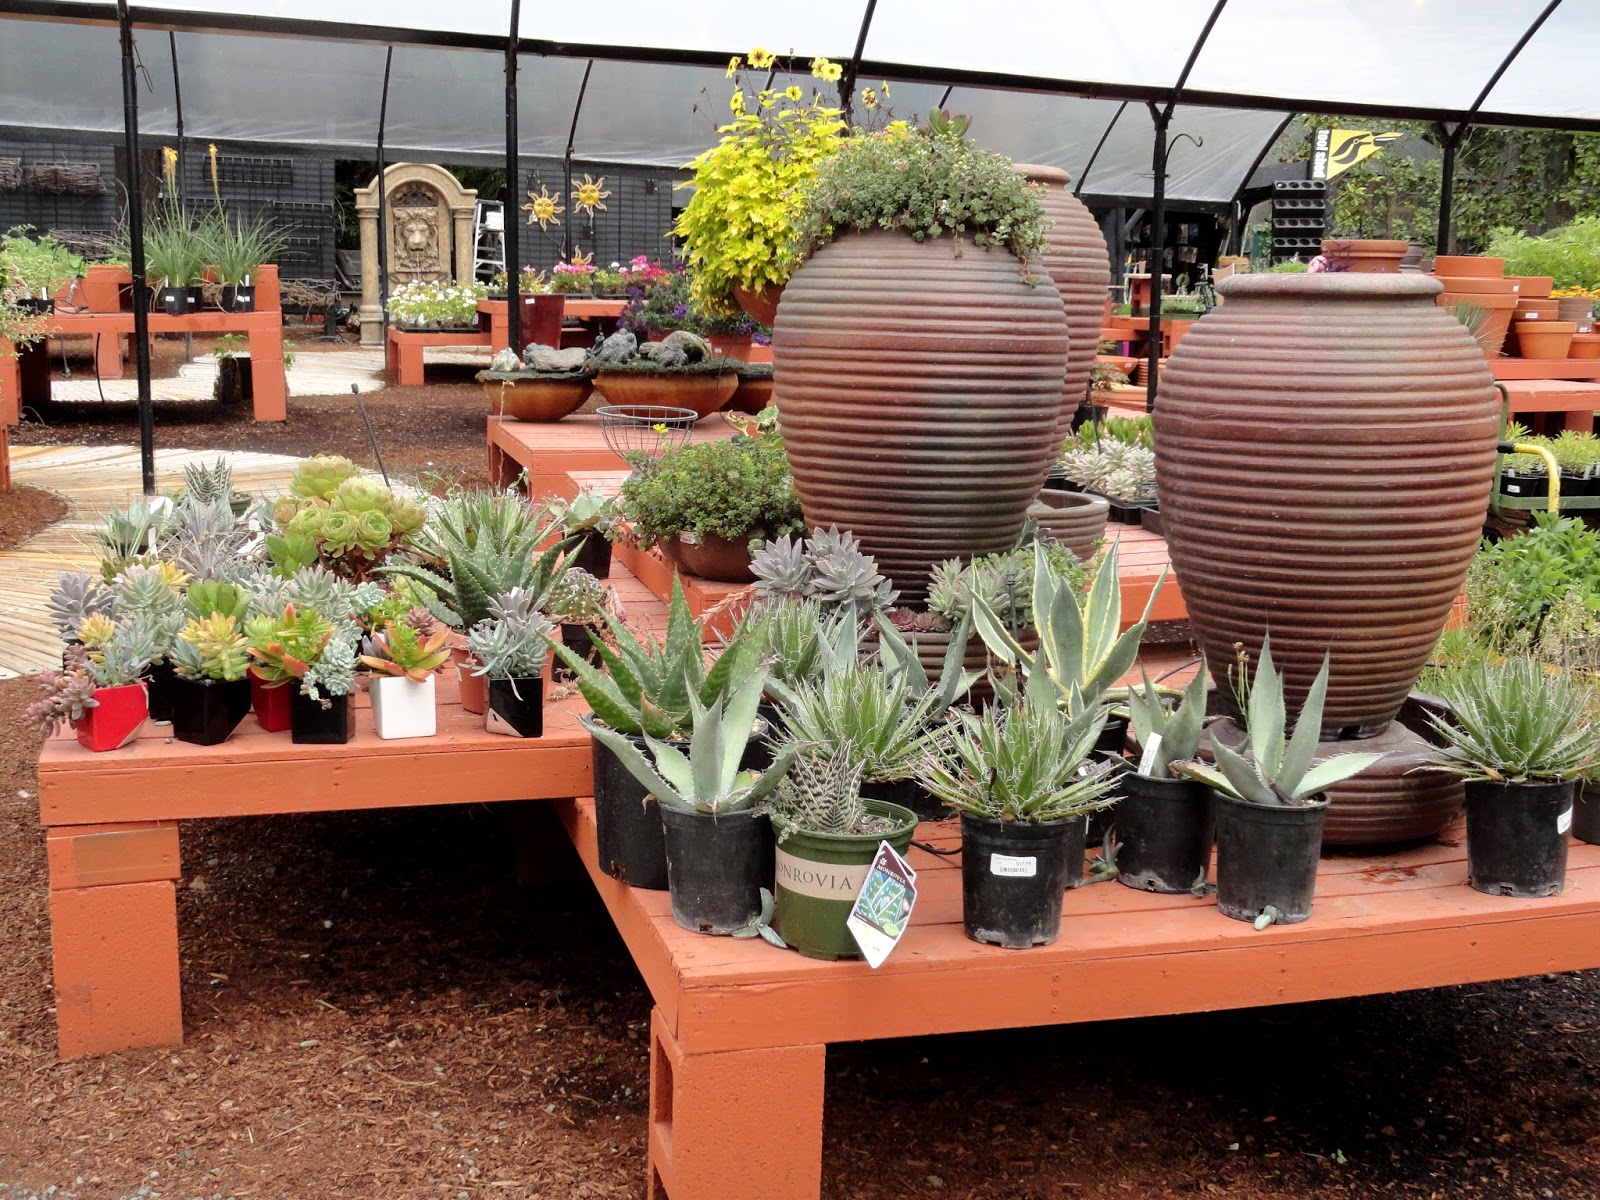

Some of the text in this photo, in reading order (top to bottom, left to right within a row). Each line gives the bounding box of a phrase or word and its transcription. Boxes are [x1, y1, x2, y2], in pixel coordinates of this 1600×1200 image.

[1313, 130, 1330, 177] tool shed
[877, 864, 906, 885] MONROVIA
